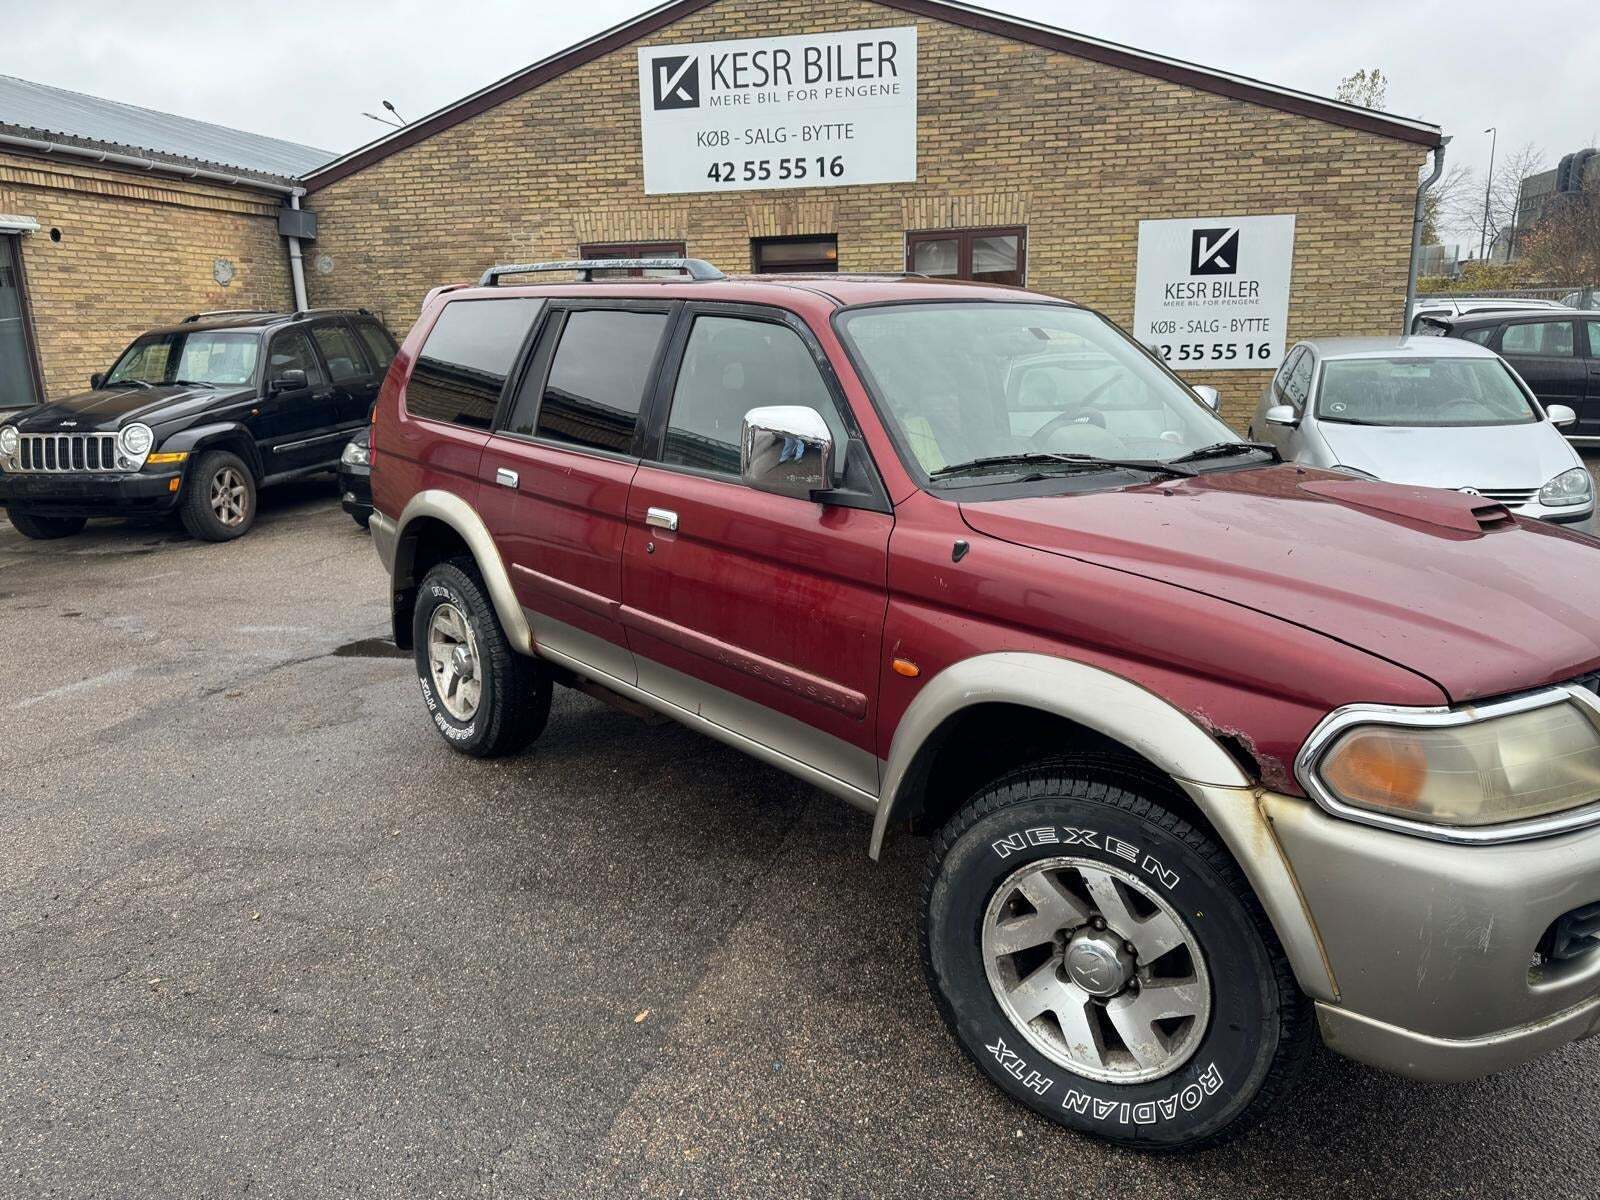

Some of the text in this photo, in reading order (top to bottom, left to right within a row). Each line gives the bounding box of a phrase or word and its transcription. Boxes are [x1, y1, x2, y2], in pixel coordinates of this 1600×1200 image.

[710, 40, 898, 91] KESR BILER
[709, 83, 900, 107] MERE BIL FOR PENGENE
[697, 130, 730, 148] KØB
[744, 127, 787, 144] SALG
[802, 123, 854, 142] BYTTE
[707, 155, 844, 183] 42 55 55 16
[1165, 280, 1259, 299] KESR BILER
[1150, 320, 1176, 334] KØB
[1187, 319, 1219, 333] SALG
[1230, 318, 1270, 332] BYTTE
[1160, 342, 1271, 360] 2 55 55 16
[991, 826, 1180, 890] NEXEN
[985, 1037, 1224, 1125] ROADIAN HTX
